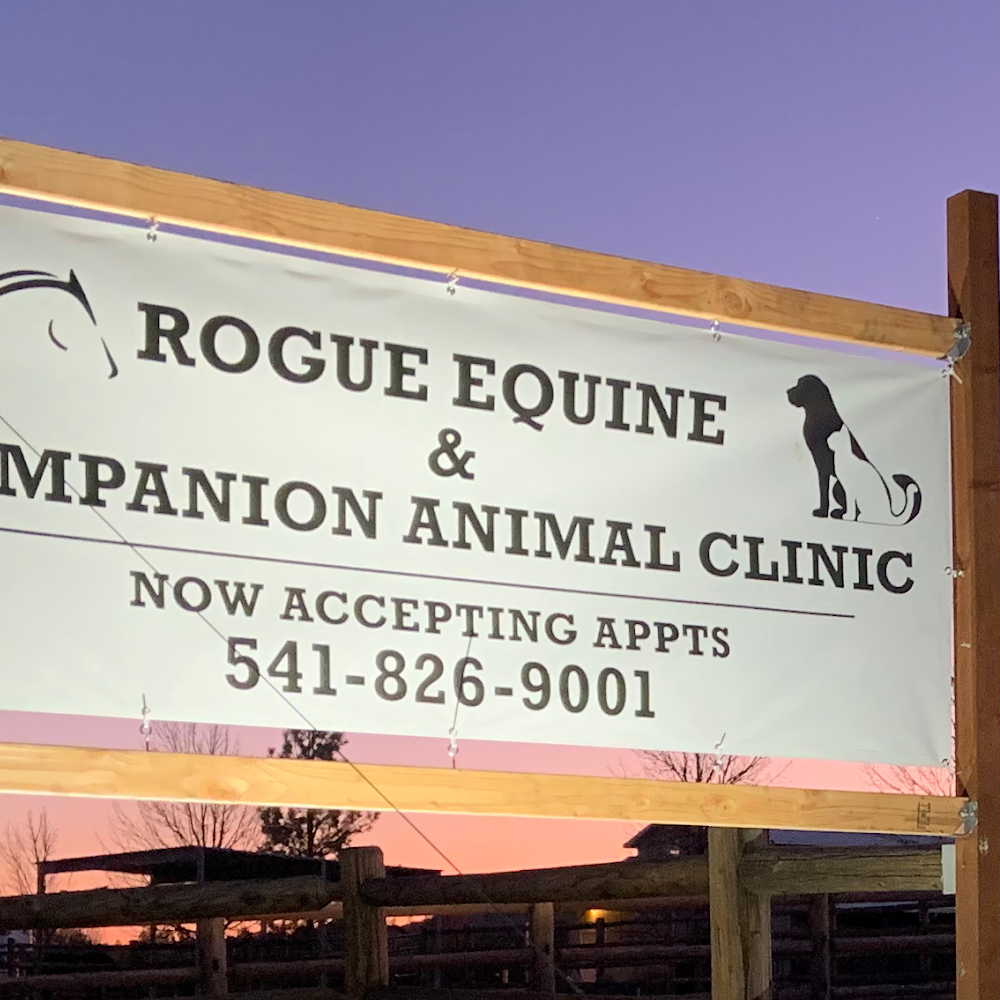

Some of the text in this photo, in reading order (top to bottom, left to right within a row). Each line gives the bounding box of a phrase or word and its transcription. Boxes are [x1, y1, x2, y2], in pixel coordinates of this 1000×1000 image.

[136, 301, 727, 446] ROGUE EQUINE
[428, 428, 475, 480] &
[0, 442, 915, 595] MPANION ANIMAL CLINIC
[129, 571, 731, 659] NOW ACCEPTING APPTS
[226, 637, 656, 718] 541-826-9001
